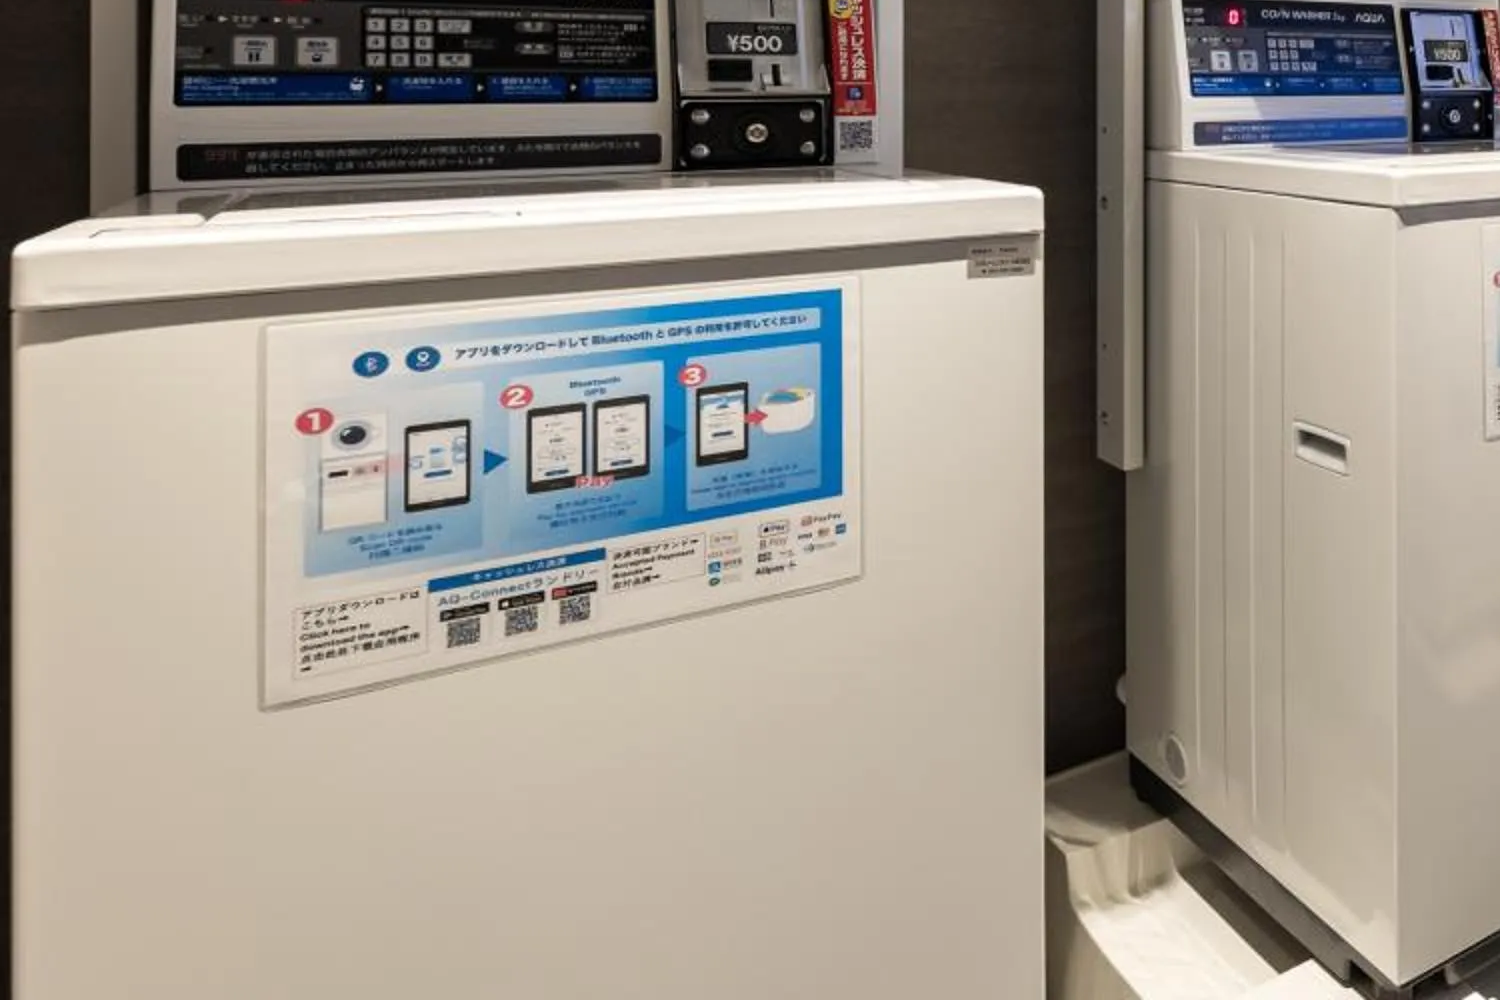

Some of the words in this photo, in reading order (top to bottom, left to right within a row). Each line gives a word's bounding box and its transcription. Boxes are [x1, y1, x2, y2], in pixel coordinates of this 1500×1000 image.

[726, 33, 784, 53] ¥500
[455, 336, 589, 361] アプリをダウンロードして
[591, 325, 654, 346] Bluetooth
[667, 324, 693, 338] GPS
